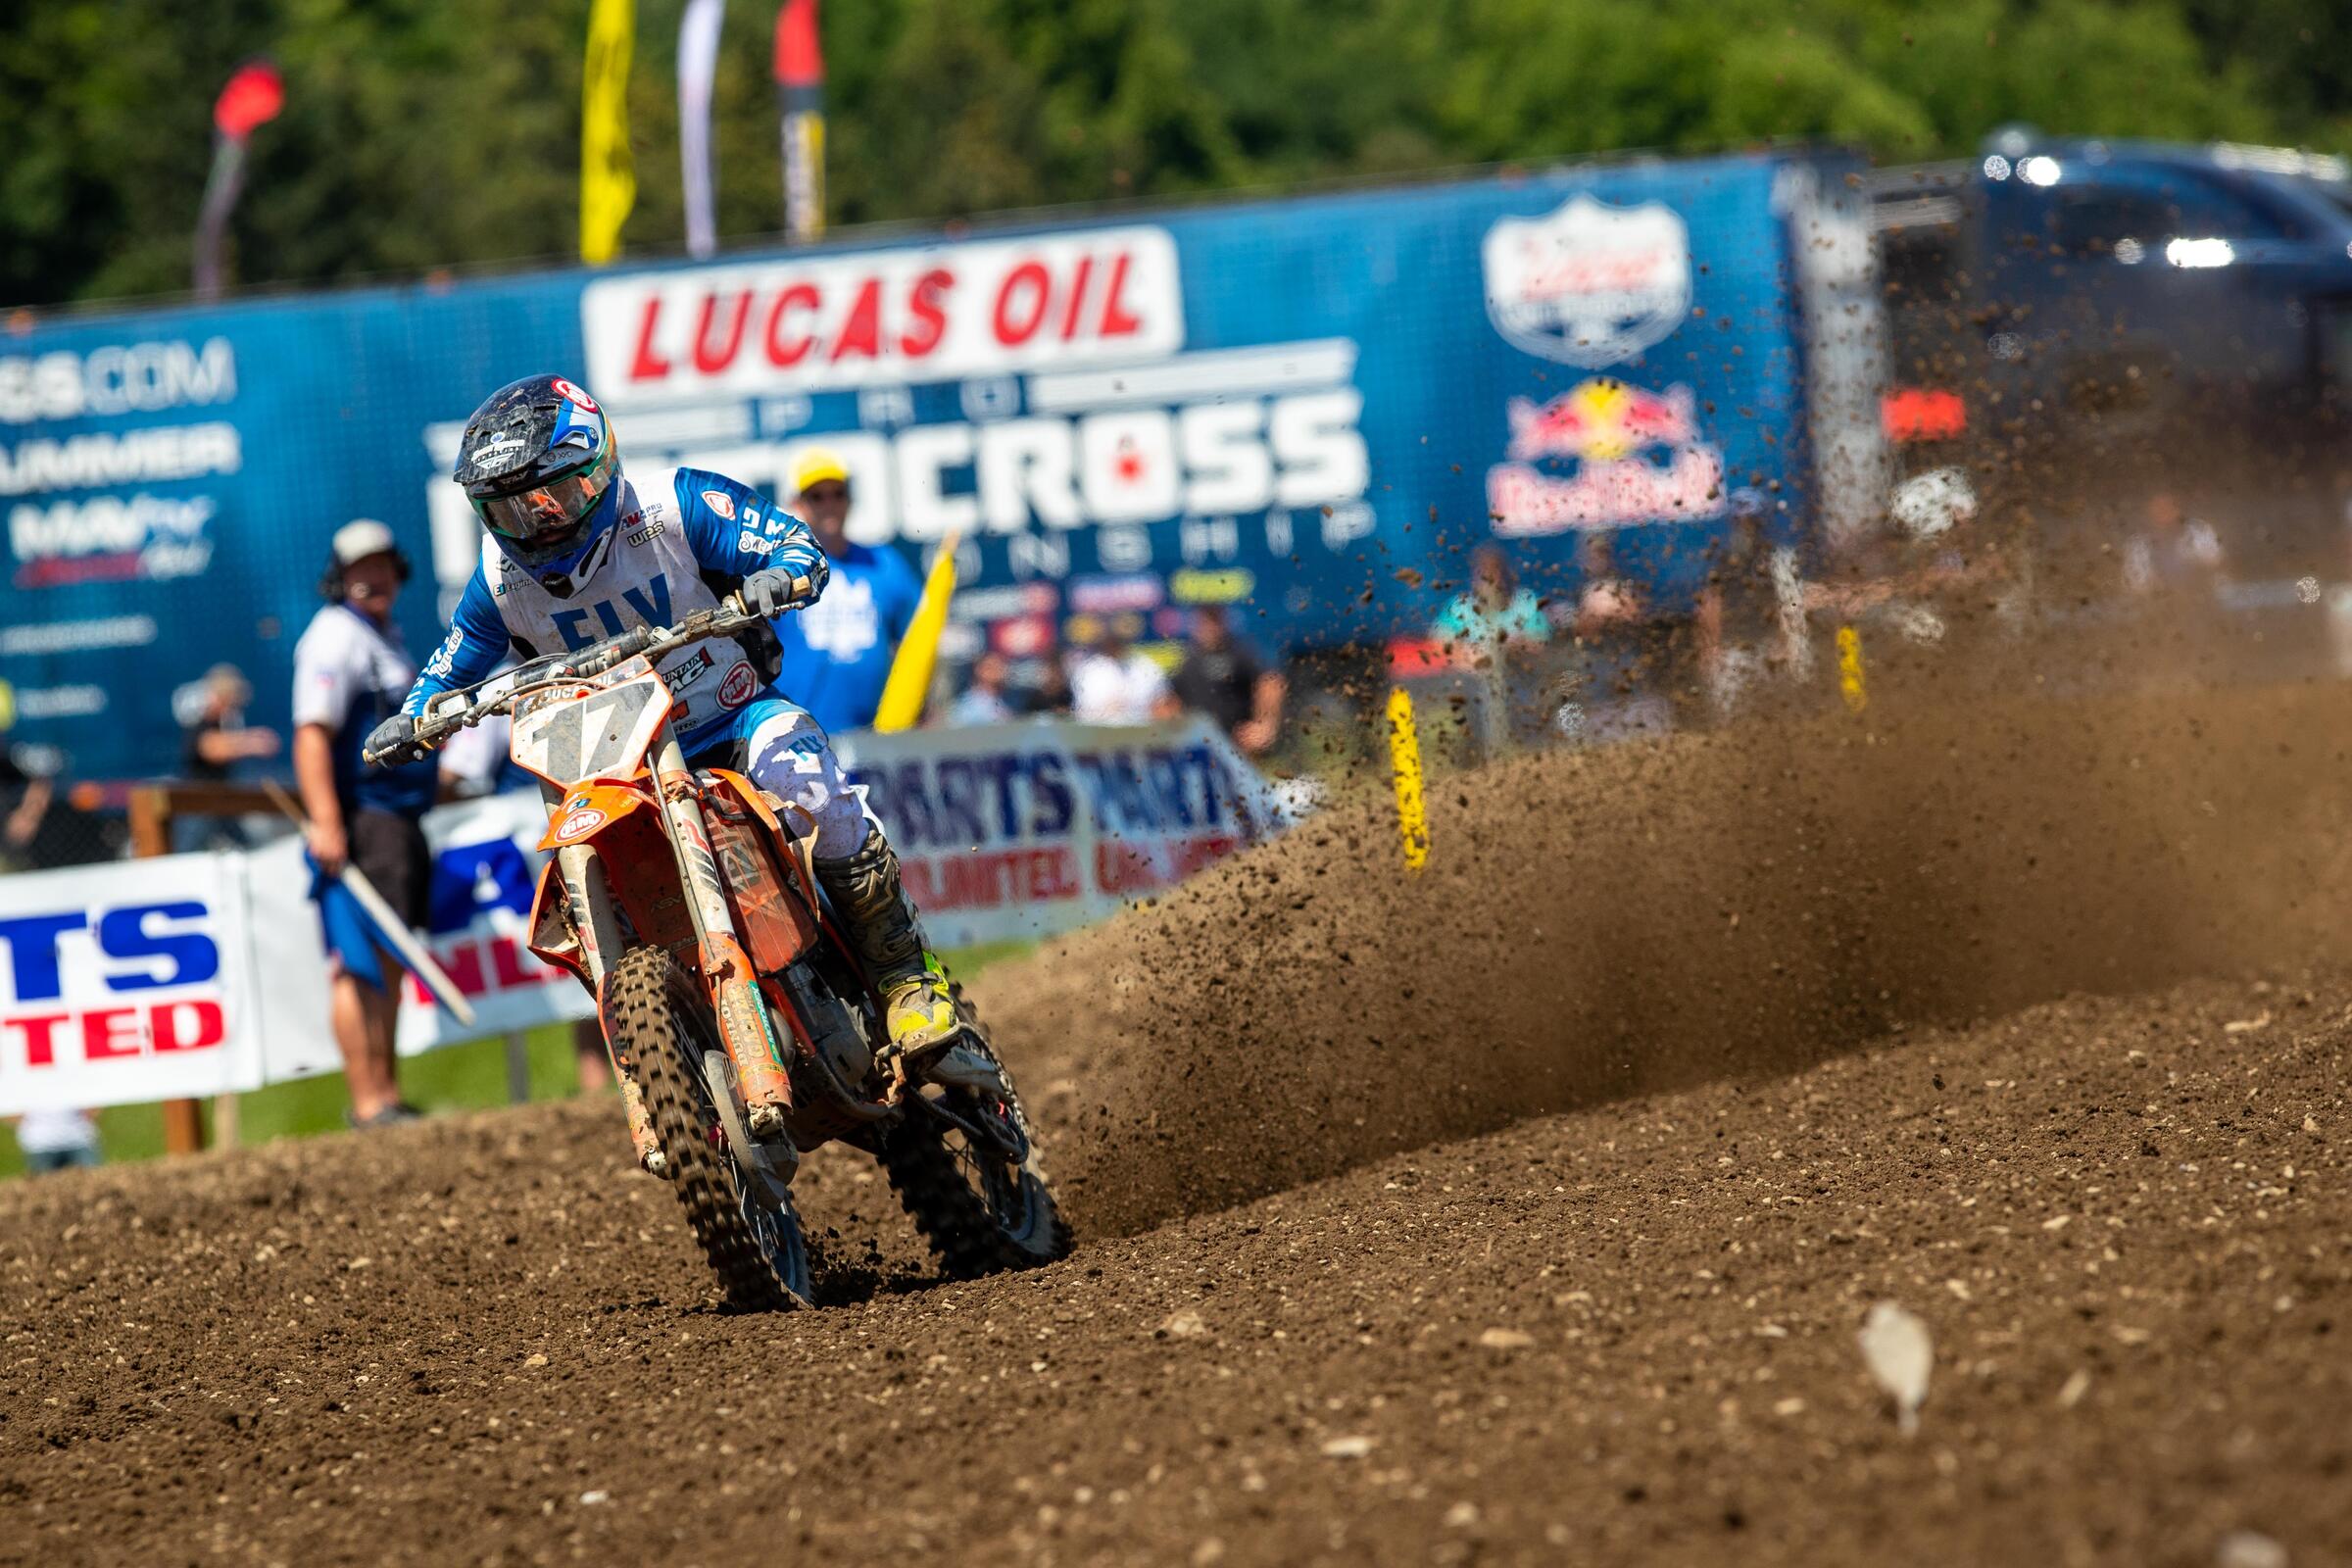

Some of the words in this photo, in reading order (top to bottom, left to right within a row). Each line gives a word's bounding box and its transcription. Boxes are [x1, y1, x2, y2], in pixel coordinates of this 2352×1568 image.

[630, 267, 956, 383] LUCAS
[992, 251, 1143, 346] OIL
[627, 520, 665, 548] WPS
[662, 654, 701, 683] UNTAIN
[532, 681, 655, 784] 17
[4, 1001, 224, 1066] TED
